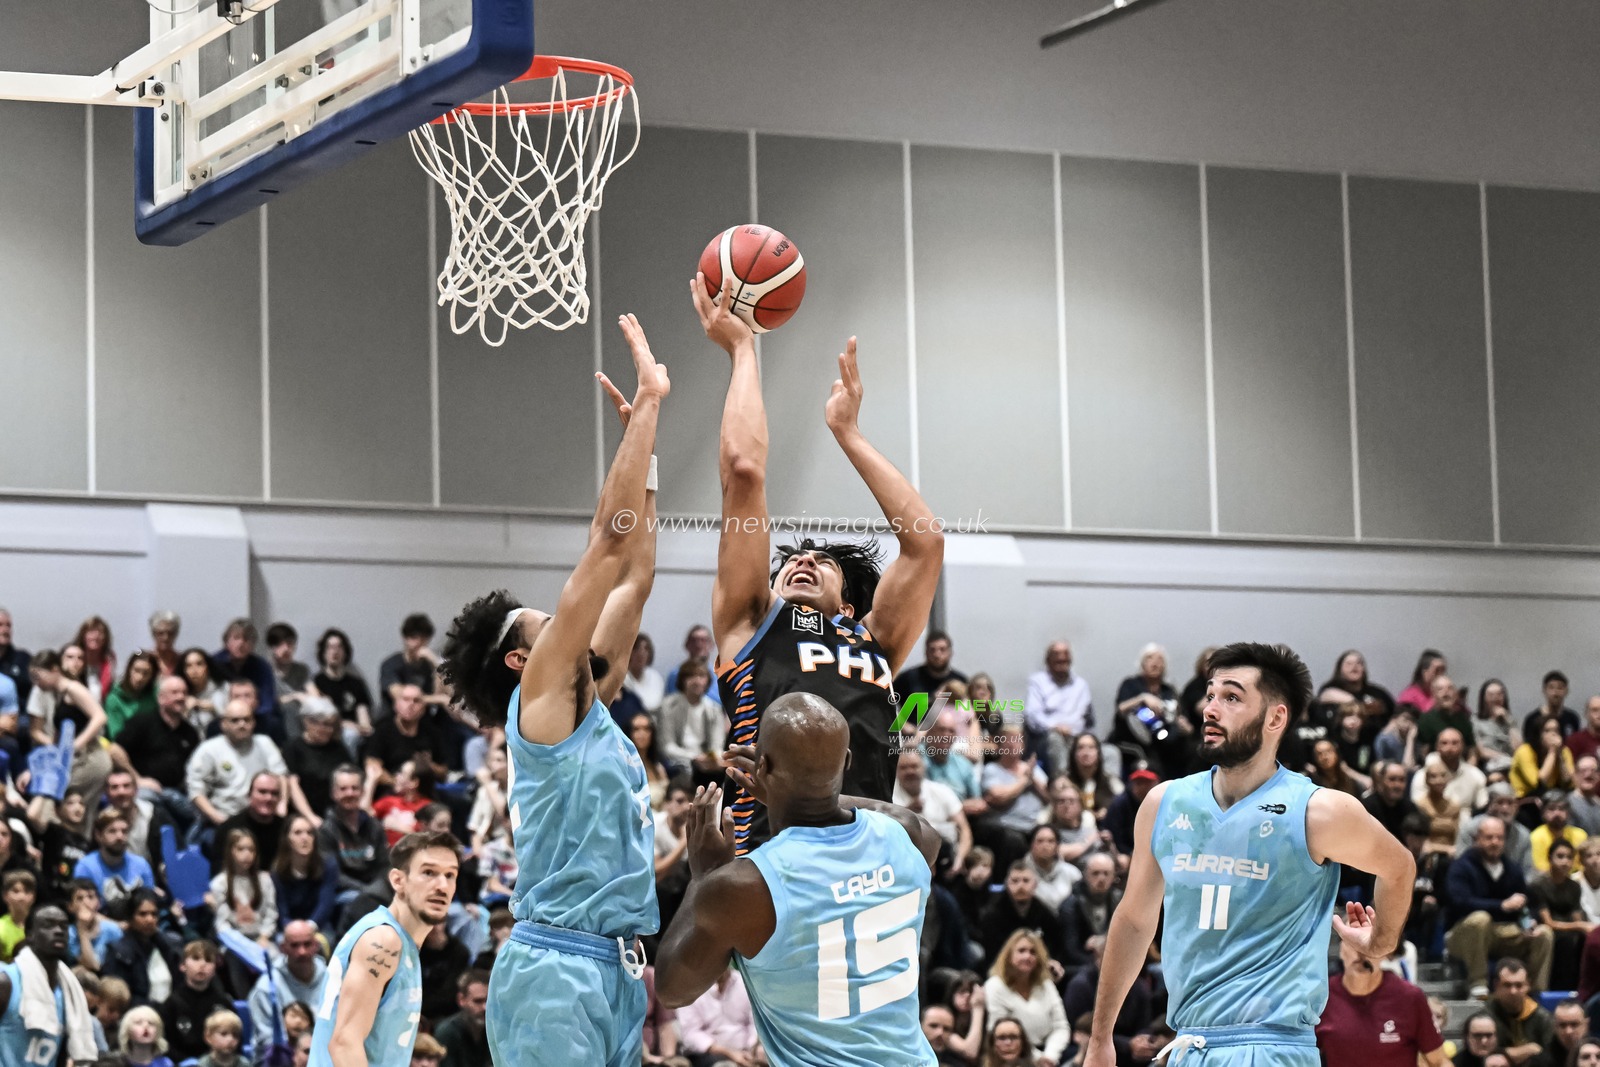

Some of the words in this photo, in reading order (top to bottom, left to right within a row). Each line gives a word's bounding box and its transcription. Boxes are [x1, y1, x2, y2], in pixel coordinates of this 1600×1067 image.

[830, 864, 895, 904] TAYO
[1172, 853, 1270, 881] SURREY
[1198, 884, 1232, 930] 11
[818, 888, 921, 1022] 15
[24, 1036, 58, 1066] 10
